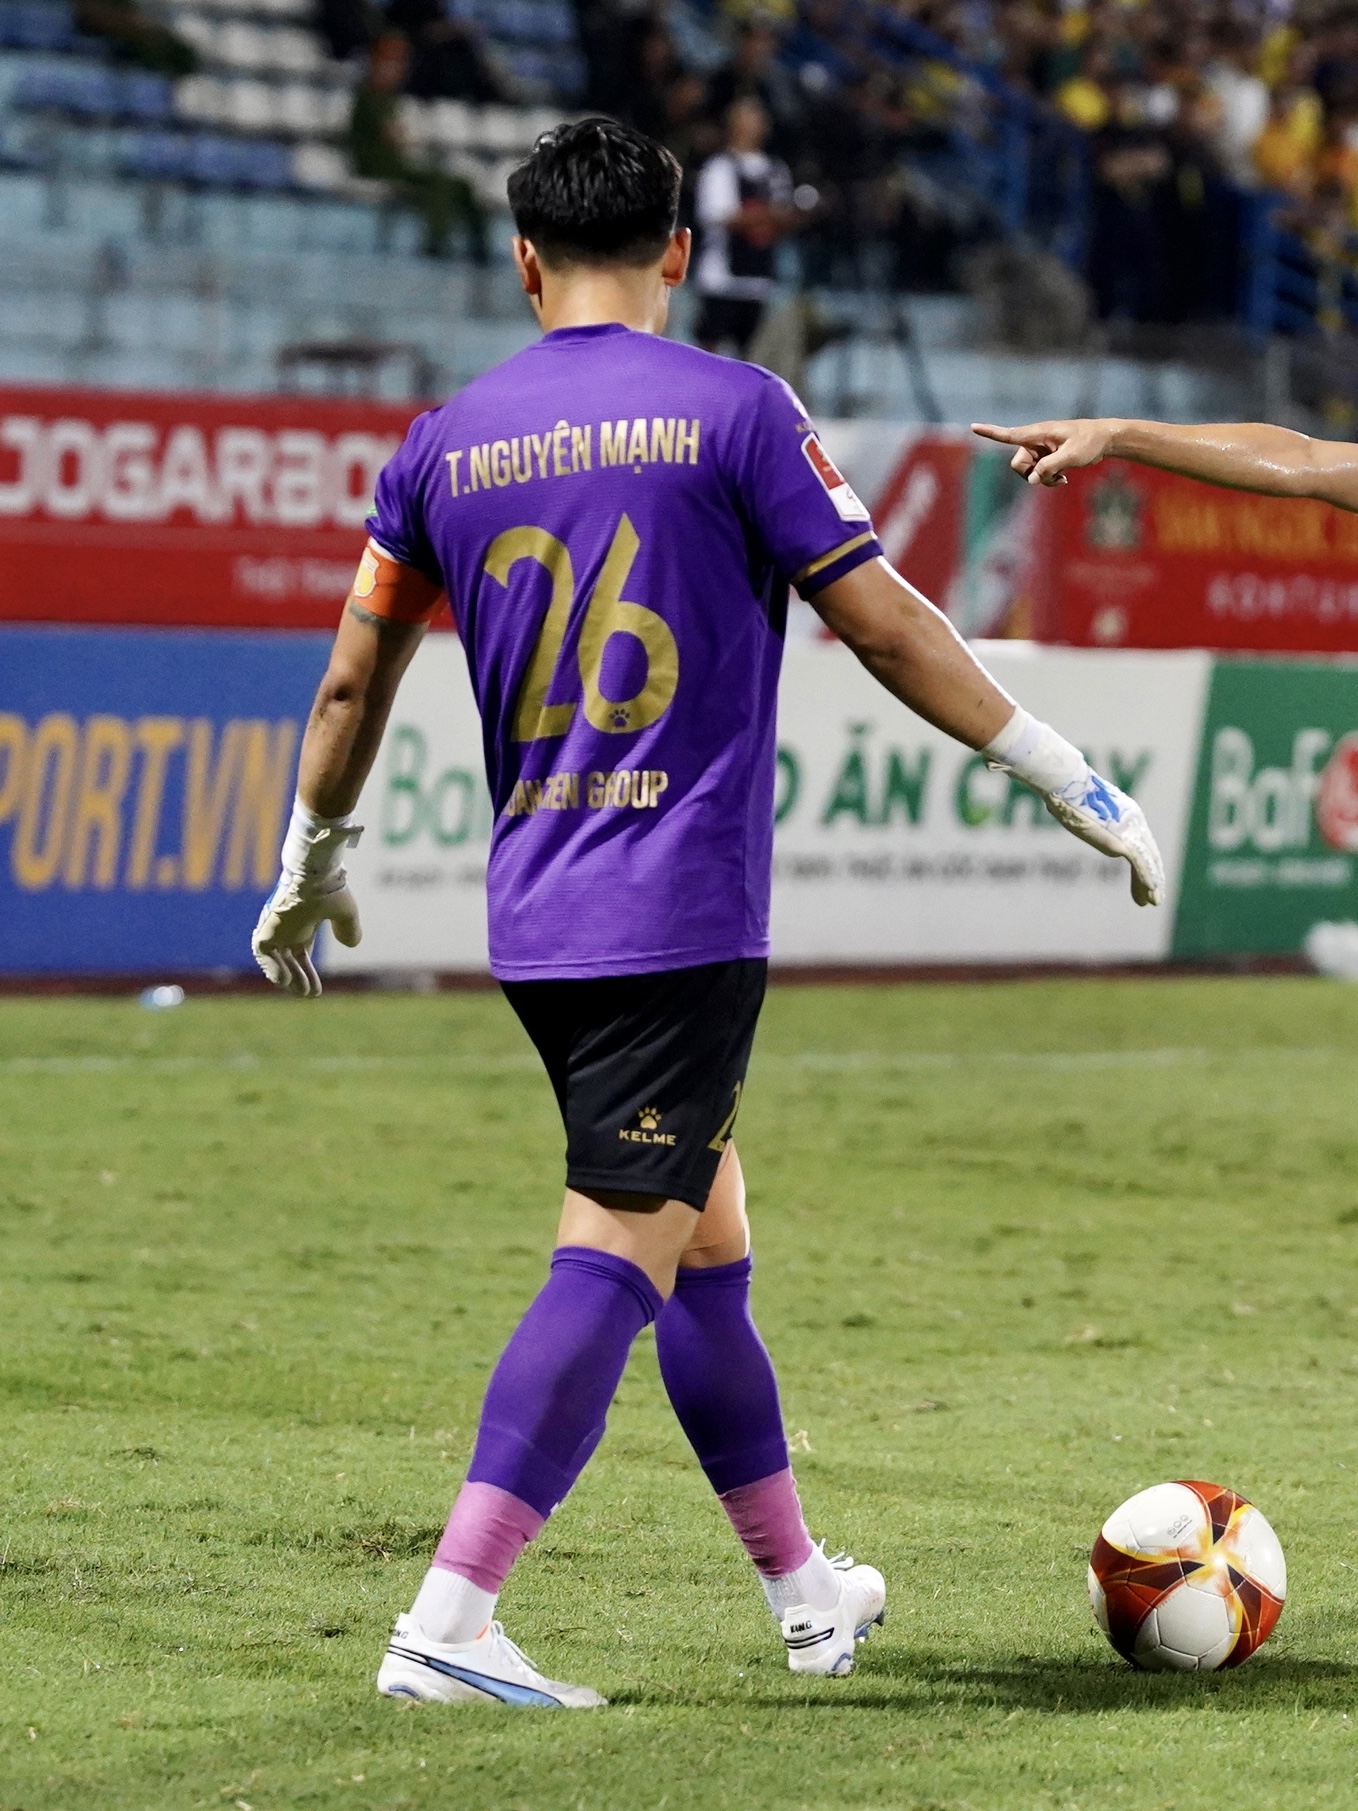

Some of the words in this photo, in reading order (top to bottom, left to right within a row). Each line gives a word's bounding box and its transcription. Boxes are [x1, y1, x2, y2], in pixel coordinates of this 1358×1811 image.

[0, 413, 402, 528] JOGARBO
[445, 419, 593, 497] T.NGUYÊN
[600, 417, 700, 475] MẠNH
[485, 512, 680, 744] 26
[618, 1128, 677, 1146] KELME
